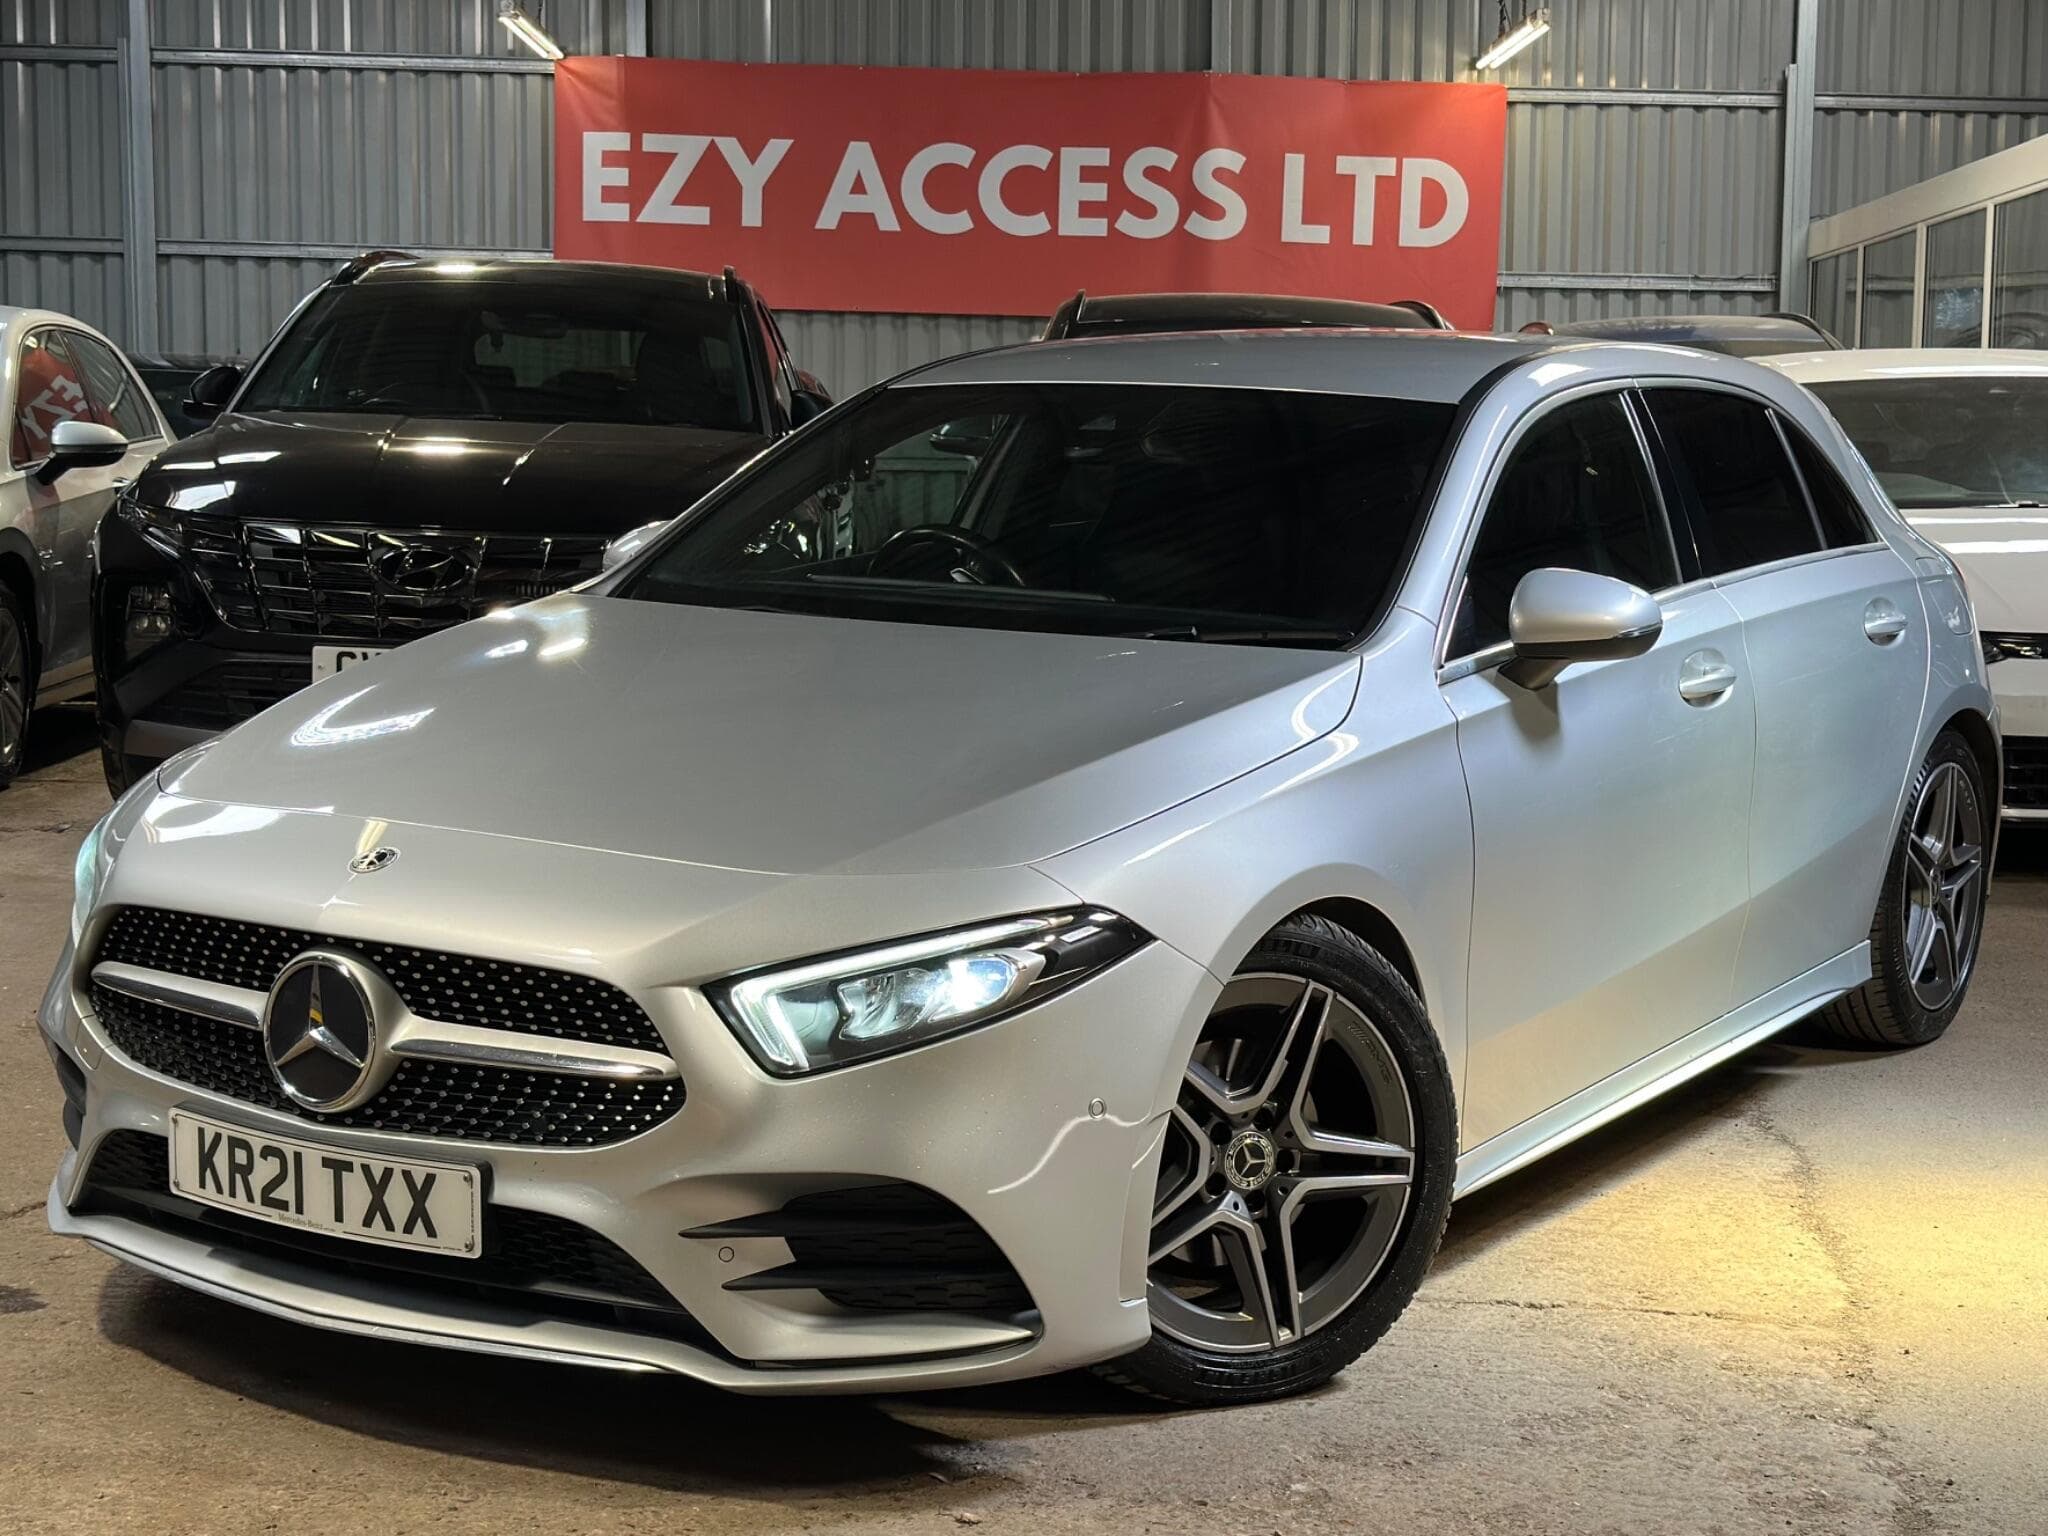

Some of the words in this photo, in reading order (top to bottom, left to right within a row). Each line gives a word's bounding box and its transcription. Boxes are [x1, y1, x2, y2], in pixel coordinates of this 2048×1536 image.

[582, 131, 794, 228] EZY
[815, 141, 1248, 242] ACCESS
[1281, 152, 1470, 248] LTD
[197, 1126, 304, 1216] KR21
[321, 1156, 438, 1239] TXX
